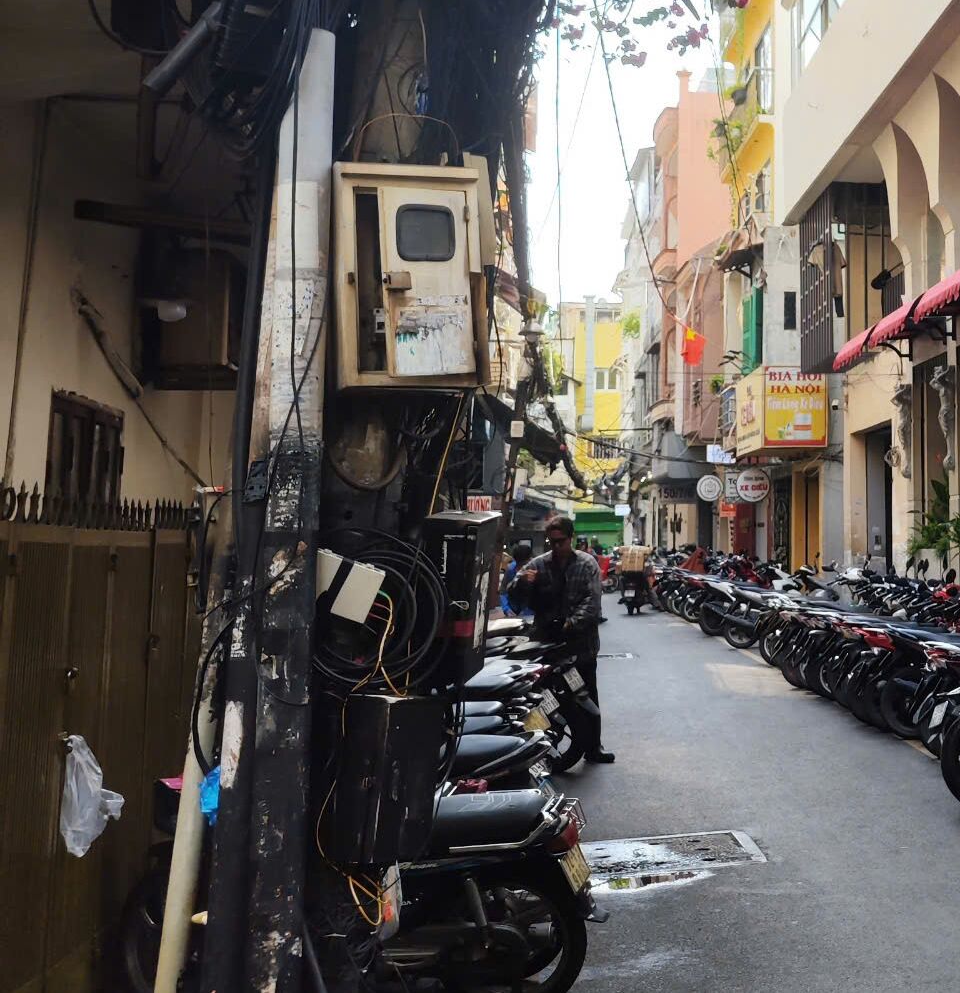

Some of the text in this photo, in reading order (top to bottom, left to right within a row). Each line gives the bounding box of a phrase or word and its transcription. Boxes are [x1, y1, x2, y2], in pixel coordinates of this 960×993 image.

[769, 371, 792, 381] BIA
[771, 383, 821, 395] HÀ NỘI
